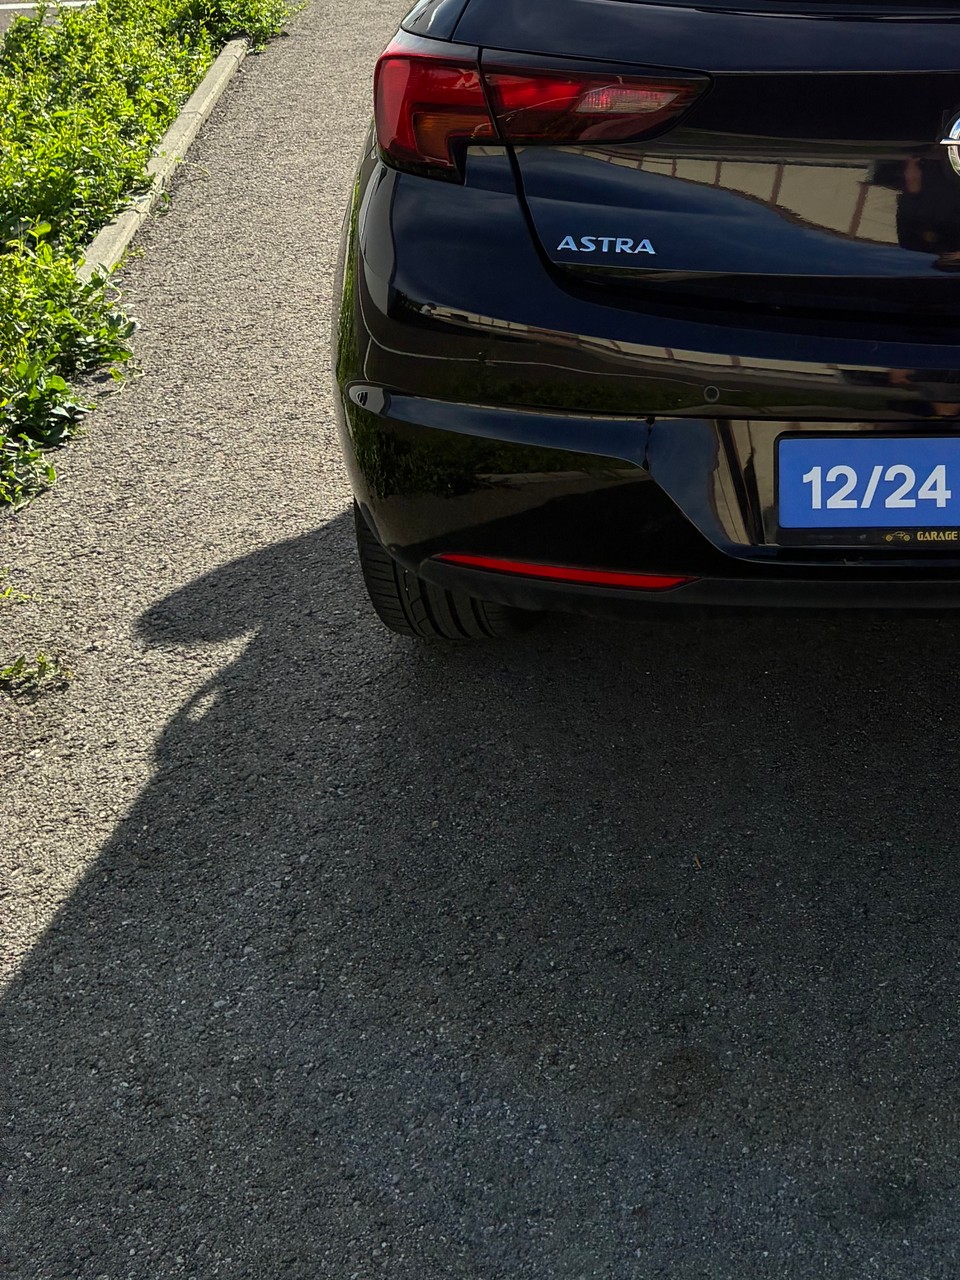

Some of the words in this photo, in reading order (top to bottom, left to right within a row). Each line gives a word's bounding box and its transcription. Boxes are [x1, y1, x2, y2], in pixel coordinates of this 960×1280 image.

[557, 235, 656, 255] ASTRA
[803, 464, 952, 510] 12/24
[917, 531, 958, 541] GARAGE
